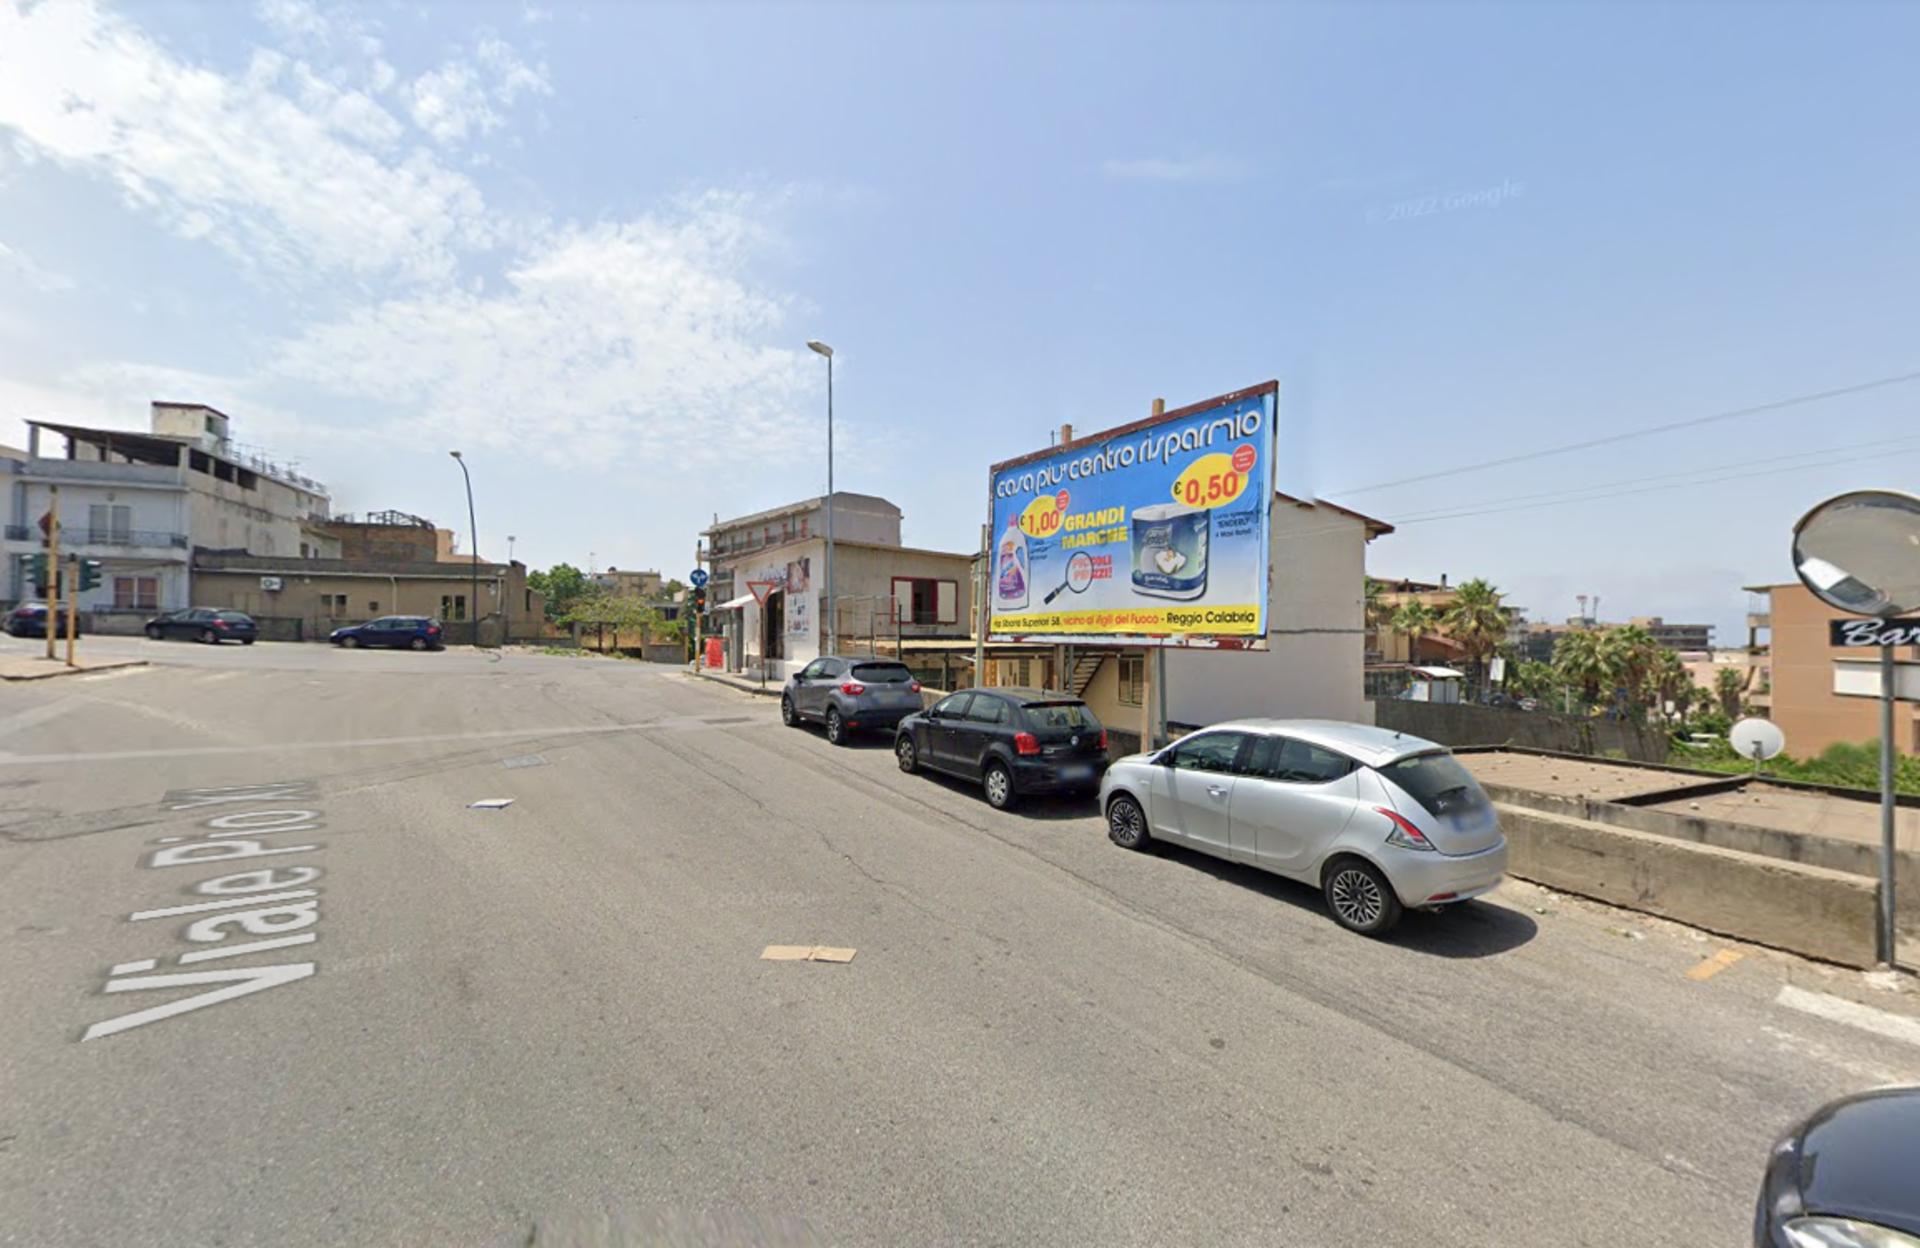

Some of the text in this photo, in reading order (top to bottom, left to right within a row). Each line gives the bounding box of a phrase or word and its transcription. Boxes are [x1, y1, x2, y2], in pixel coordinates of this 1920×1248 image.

[1068, 444, 1135, 480] centro
[1138, 405, 1262, 466] risparmio
[1186, 471, 1239, 506] 0,50
[1028, 510, 1060, 535] 1,00
[1064, 505, 1125, 532] GRANDI
[1062, 526, 1128, 550] MARCHE
[1167, 611, 1203, 626] Reggio
[1205, 610, 1256, 623] Calabria
